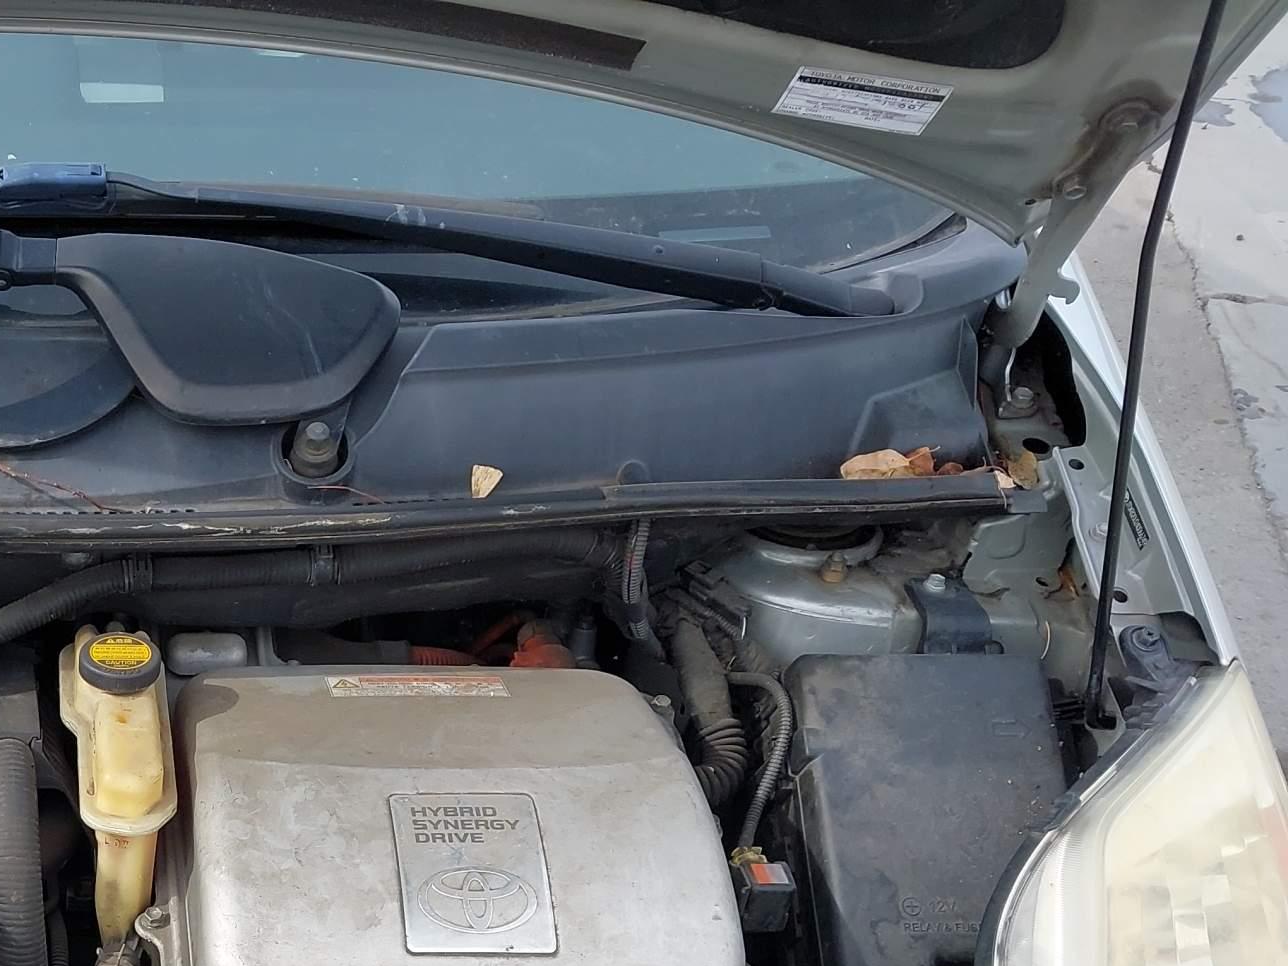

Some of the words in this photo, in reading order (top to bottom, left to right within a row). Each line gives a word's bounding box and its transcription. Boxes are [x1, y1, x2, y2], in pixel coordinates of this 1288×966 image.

[811, 71, 842, 80] TOYOTA
[847, 75, 876, 85] MOTOR
[881, 80, 941, 94] CORPORATION
[411, 806, 497, 817] HYBRID
[412, 819, 520, 830] SYNERGY
[415, 832, 485, 843] DRIVE
[903, 922, 941, 933] RELAY
